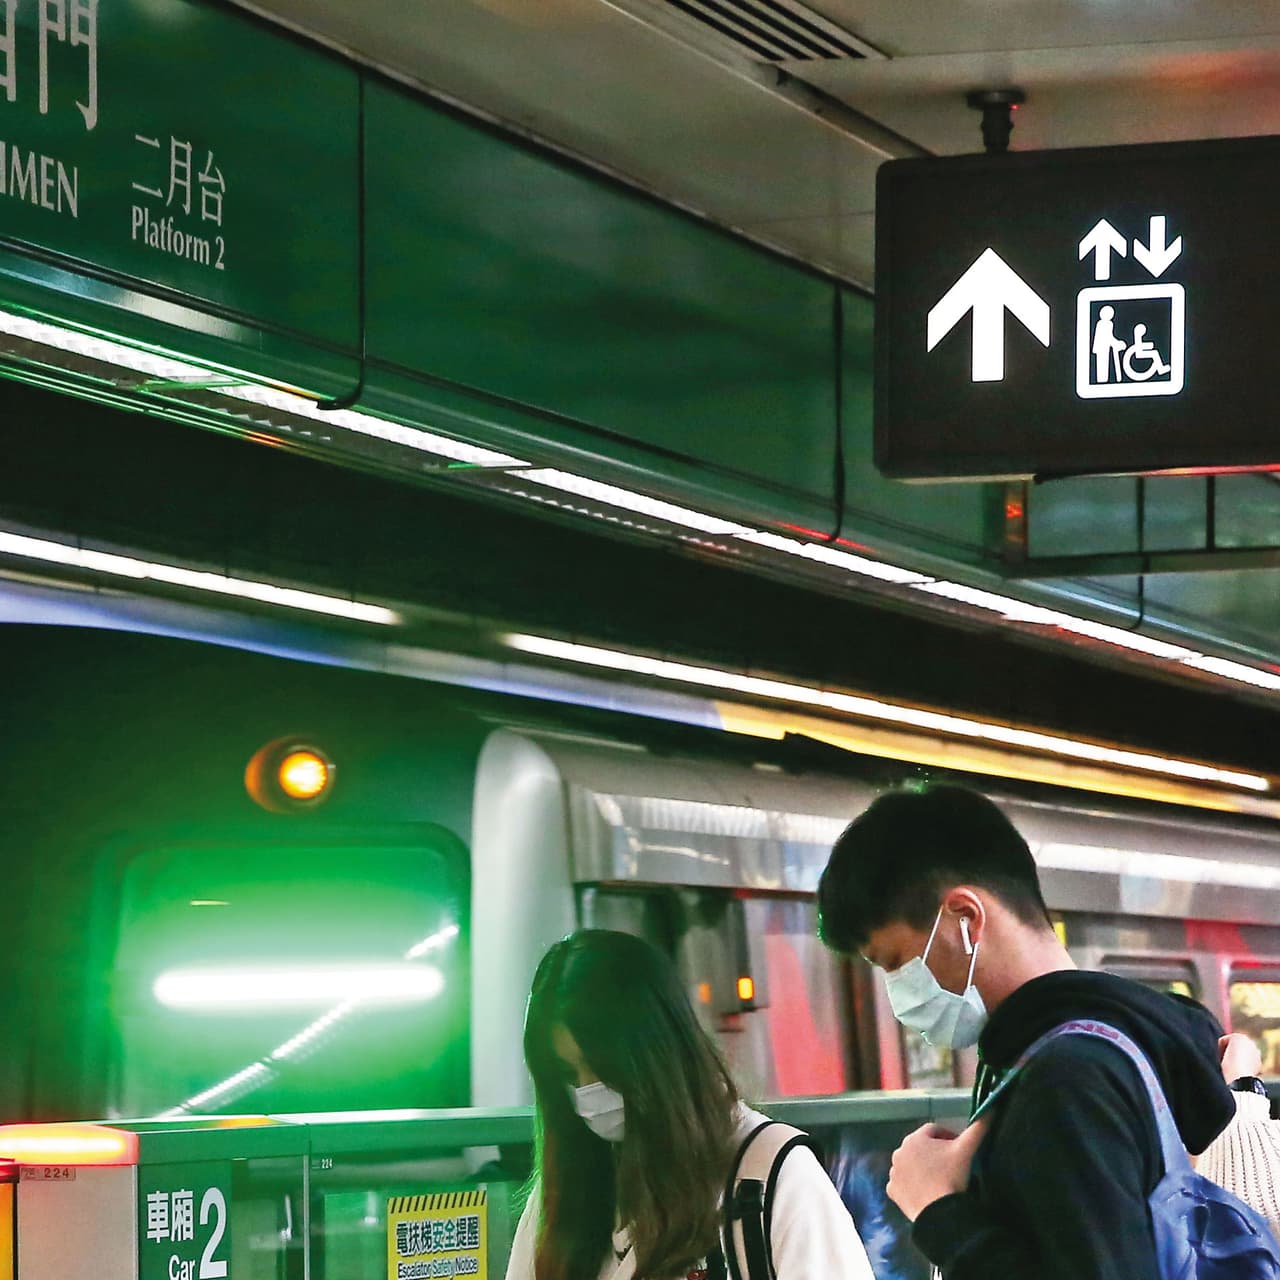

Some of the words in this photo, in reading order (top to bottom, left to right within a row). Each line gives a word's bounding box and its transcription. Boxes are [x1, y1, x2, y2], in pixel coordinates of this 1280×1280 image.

[131, 133, 225, 227] 二月台
[132, 206, 211, 266] Platform
[214, 236, 225, 270] 2
[43, 1167, 70, 1179] 224
[146, 1189, 194, 1245] 車廂
[199, 1187, 228, 1280] 2
[395, 1216, 480, 1255] 電扶梯安全提醒
[397, 1260, 431, 1280] Escalator
[455, 1256, 478, 1275] Notice
